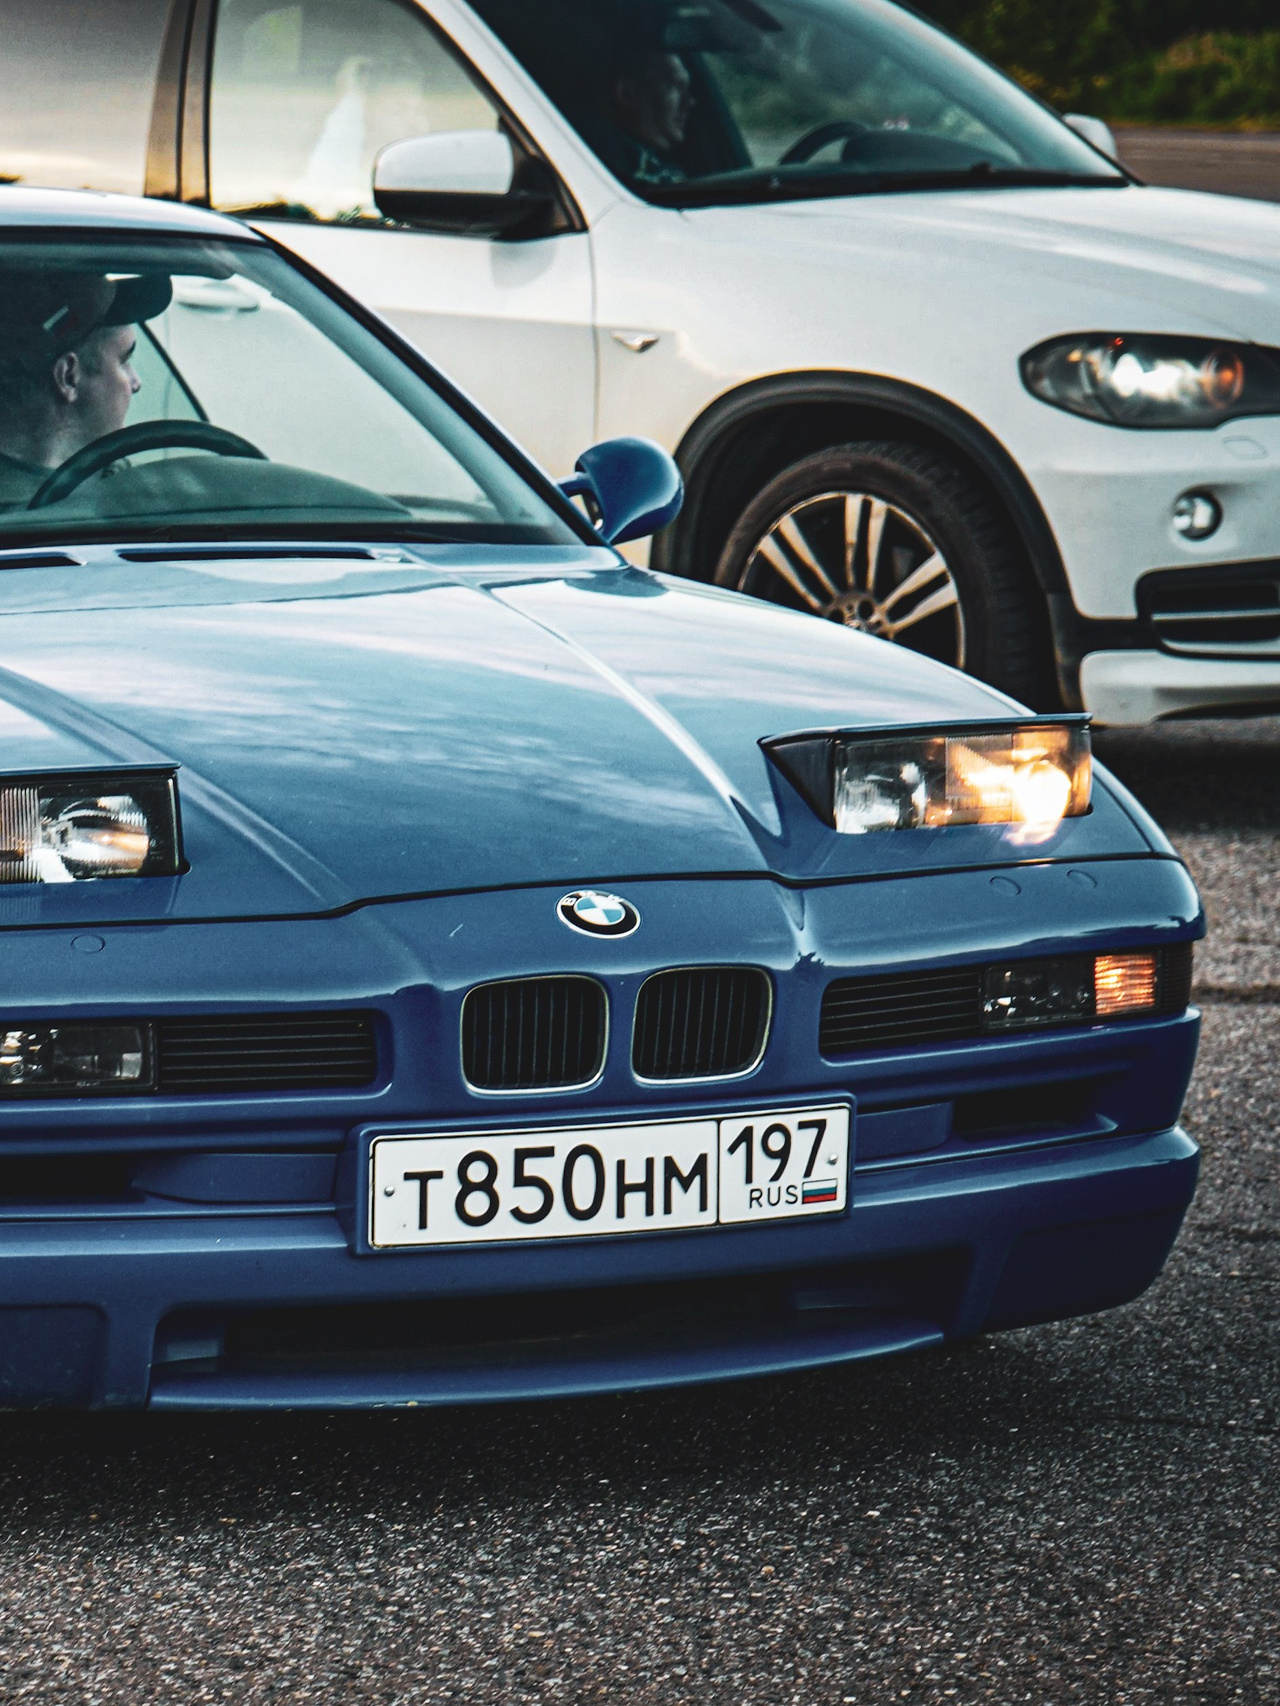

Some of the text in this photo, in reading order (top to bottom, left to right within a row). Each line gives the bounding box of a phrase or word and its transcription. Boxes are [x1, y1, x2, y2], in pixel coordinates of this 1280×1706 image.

[403, 1118, 828, 1230] T850HM 197
[748, 1184, 799, 1209] RUS
